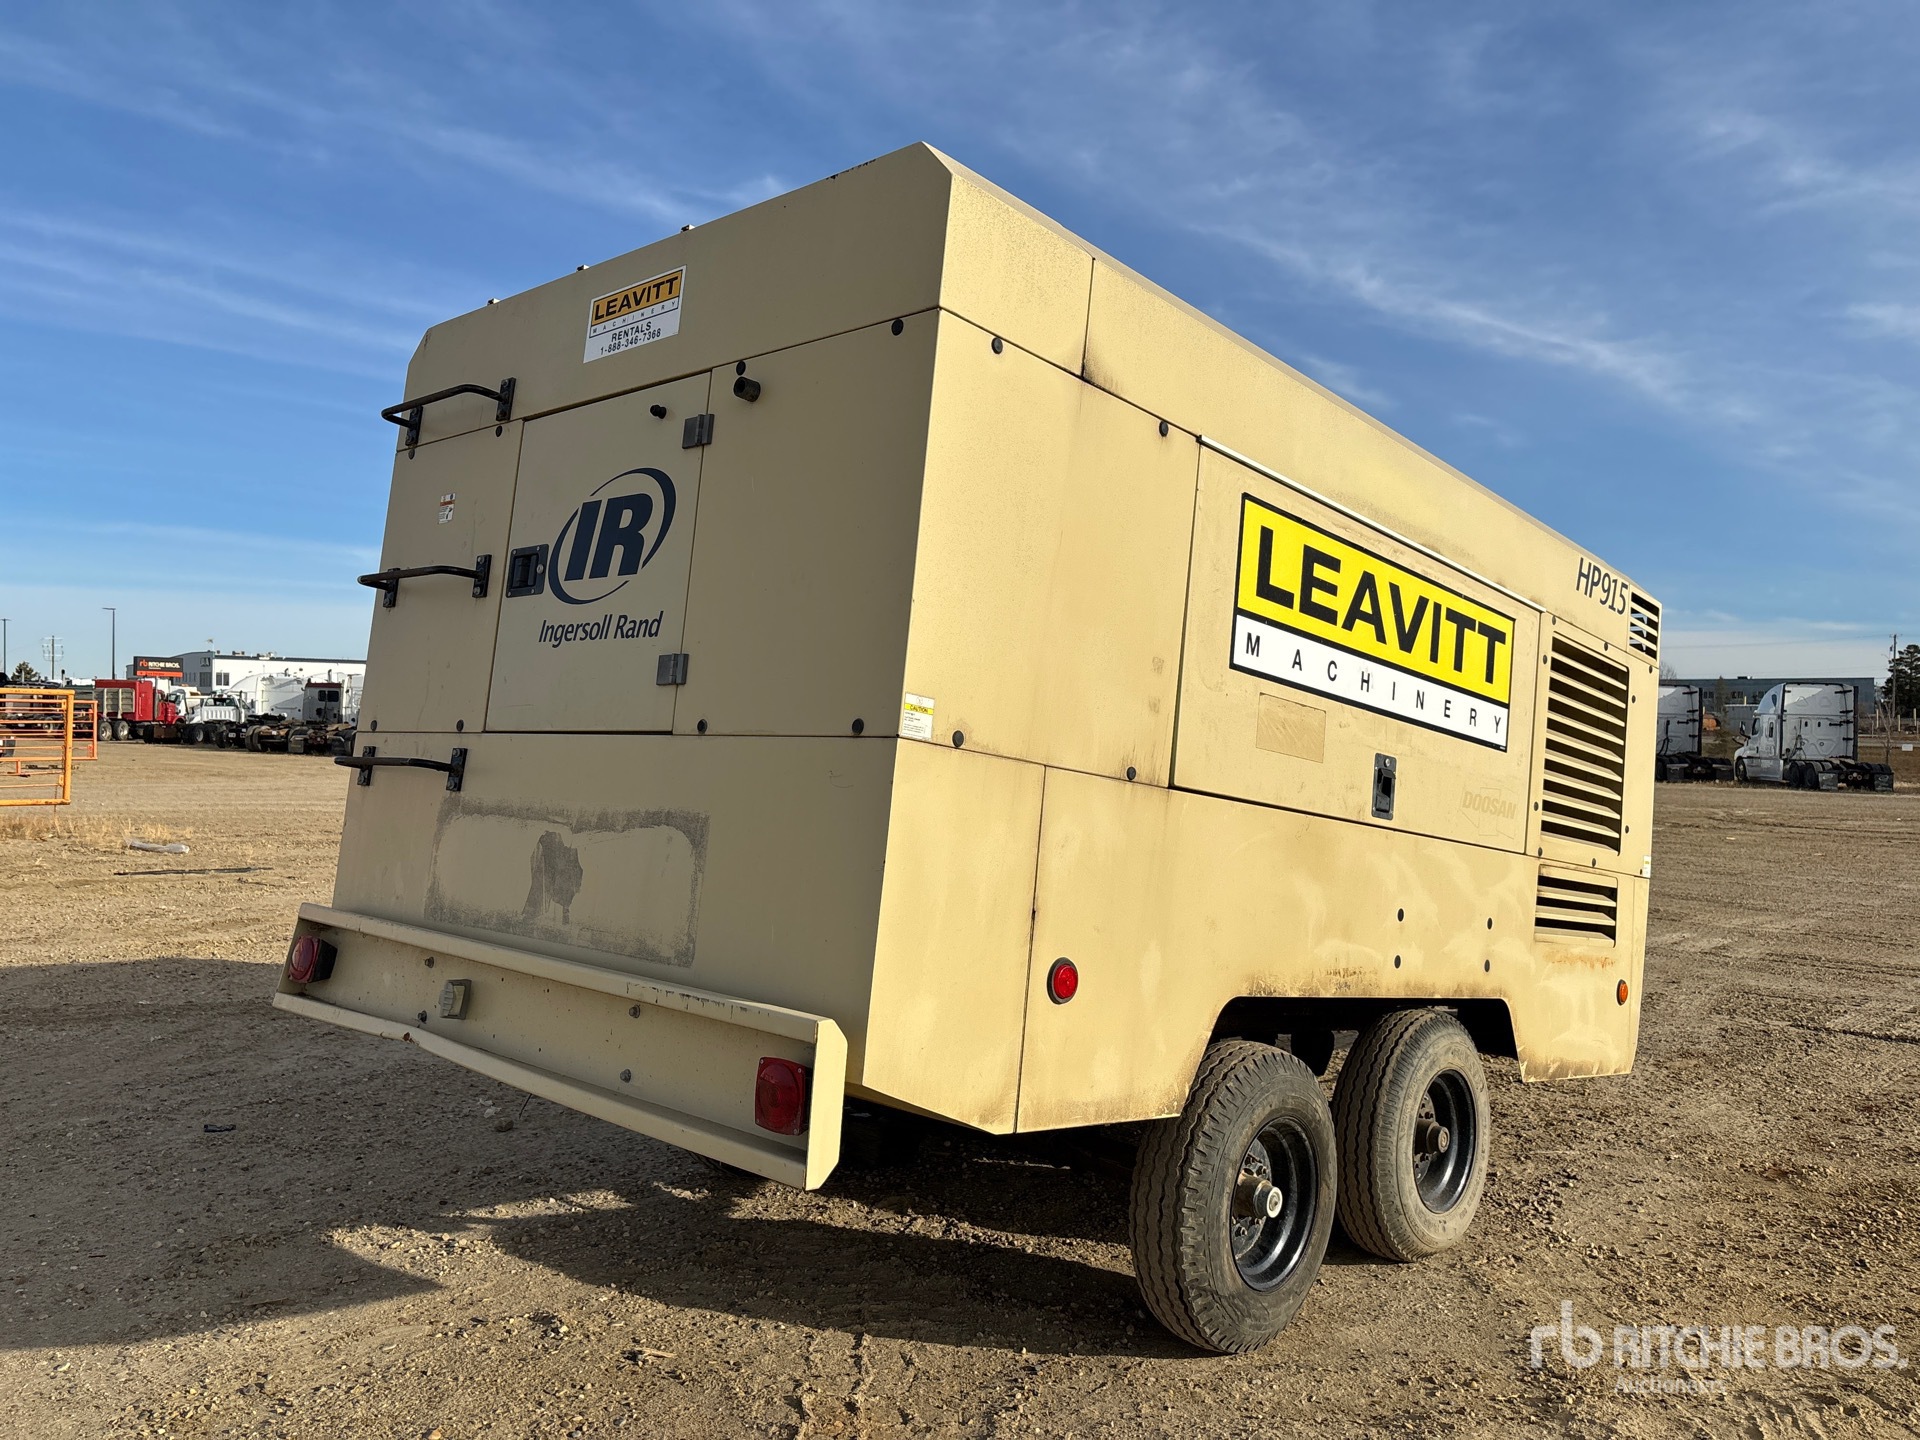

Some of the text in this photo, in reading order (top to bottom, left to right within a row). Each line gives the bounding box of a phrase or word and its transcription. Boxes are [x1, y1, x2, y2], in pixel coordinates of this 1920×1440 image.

[592, 300, 676, 334] MACHINERY
[594, 275, 679, 321] LEAVITT
[600, 328, 662, 355] 1-888-346-7368
[611, 321, 652, 342] RENTALS
[564, 492, 654, 582] IR
[1255, 525, 1507, 685] LEAVITT
[1576, 556, 1629, 616] HP915
[538, 610, 664, 648] Ingersoll Rand
[1245, 632, 1502, 734] MACHINERY
[910, 704, 928, 713] CAUTION
[1462, 790, 1517, 820] DOOSAN
